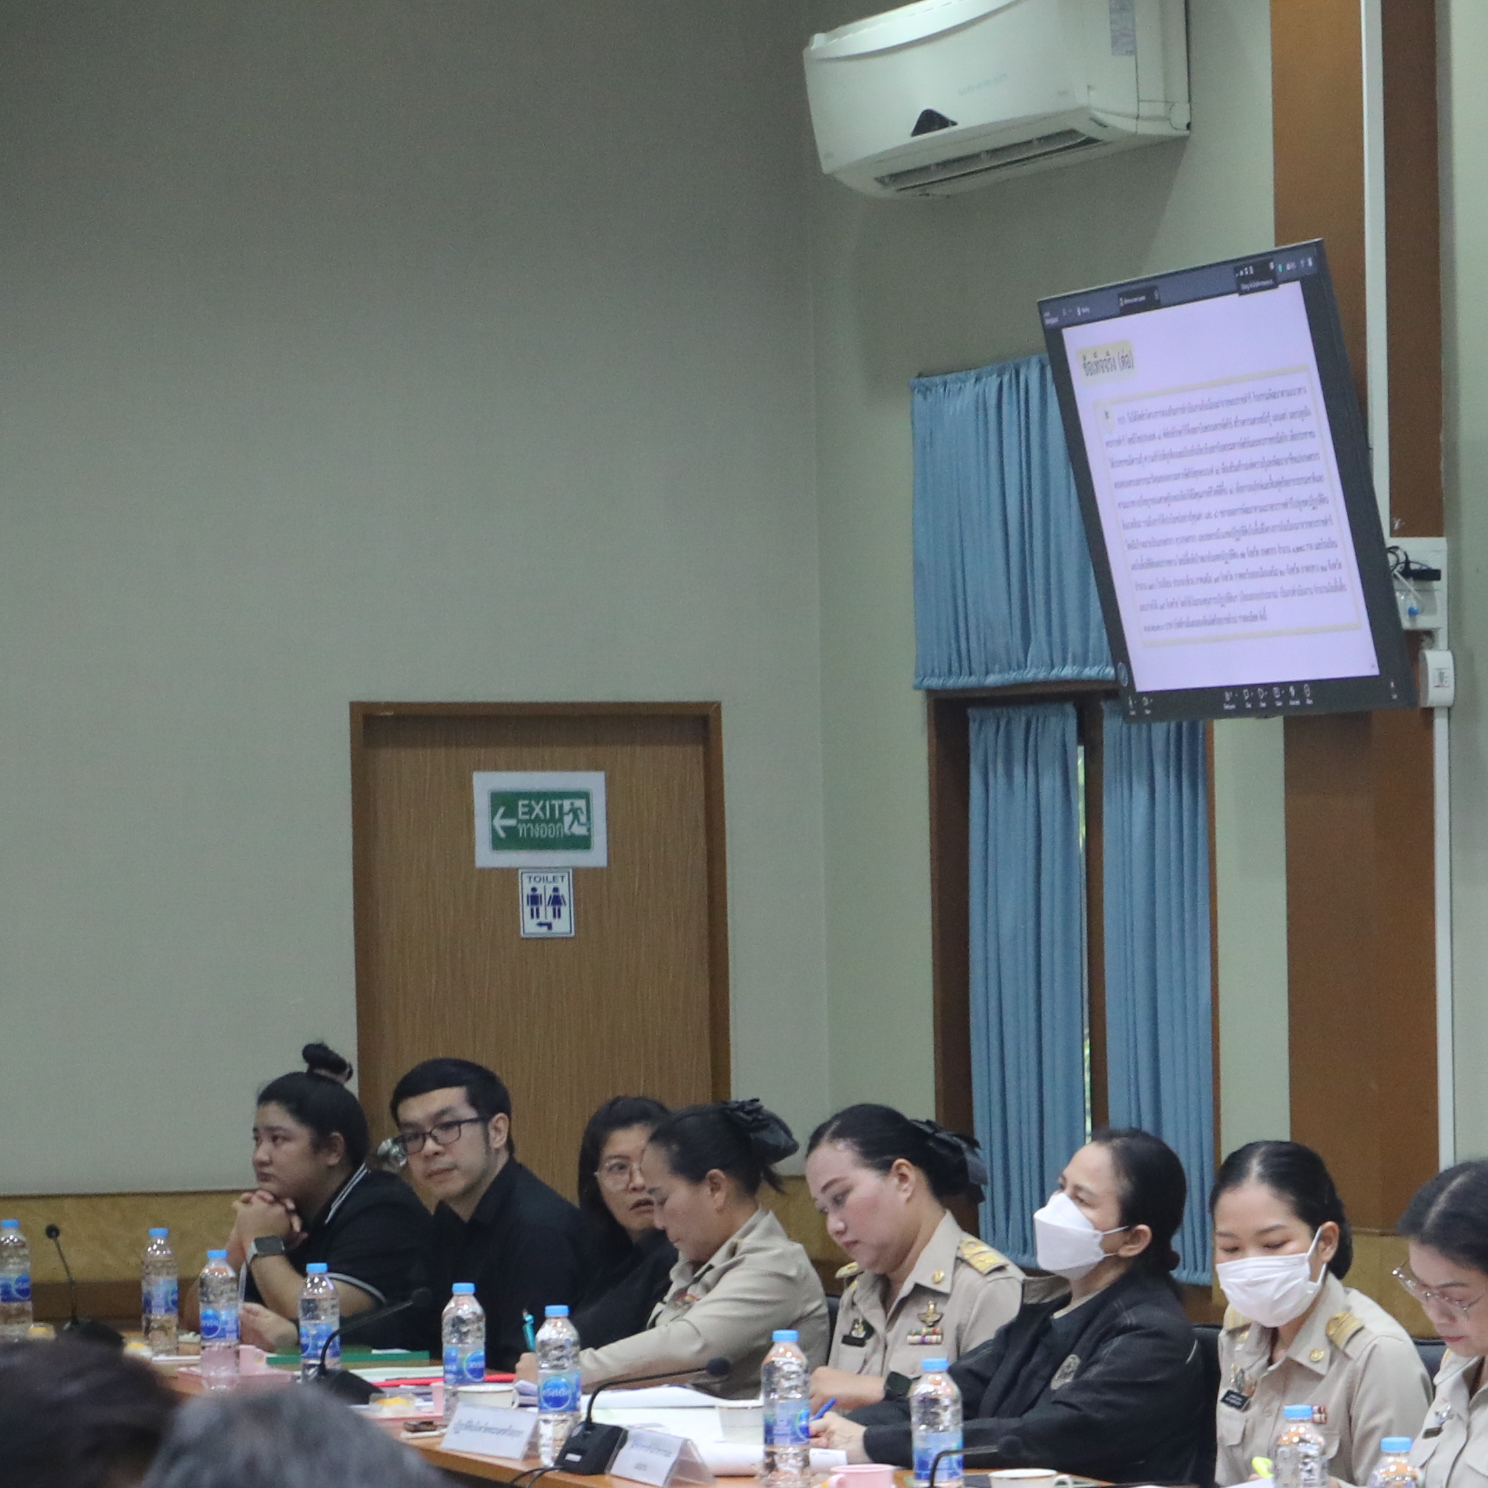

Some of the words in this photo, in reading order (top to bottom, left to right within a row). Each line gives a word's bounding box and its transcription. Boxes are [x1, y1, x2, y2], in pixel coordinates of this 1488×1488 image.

[517, 799, 564, 820] EXIT
[517, 822, 565, 839] ทางออก
[527, 875, 566, 884] TOILET
